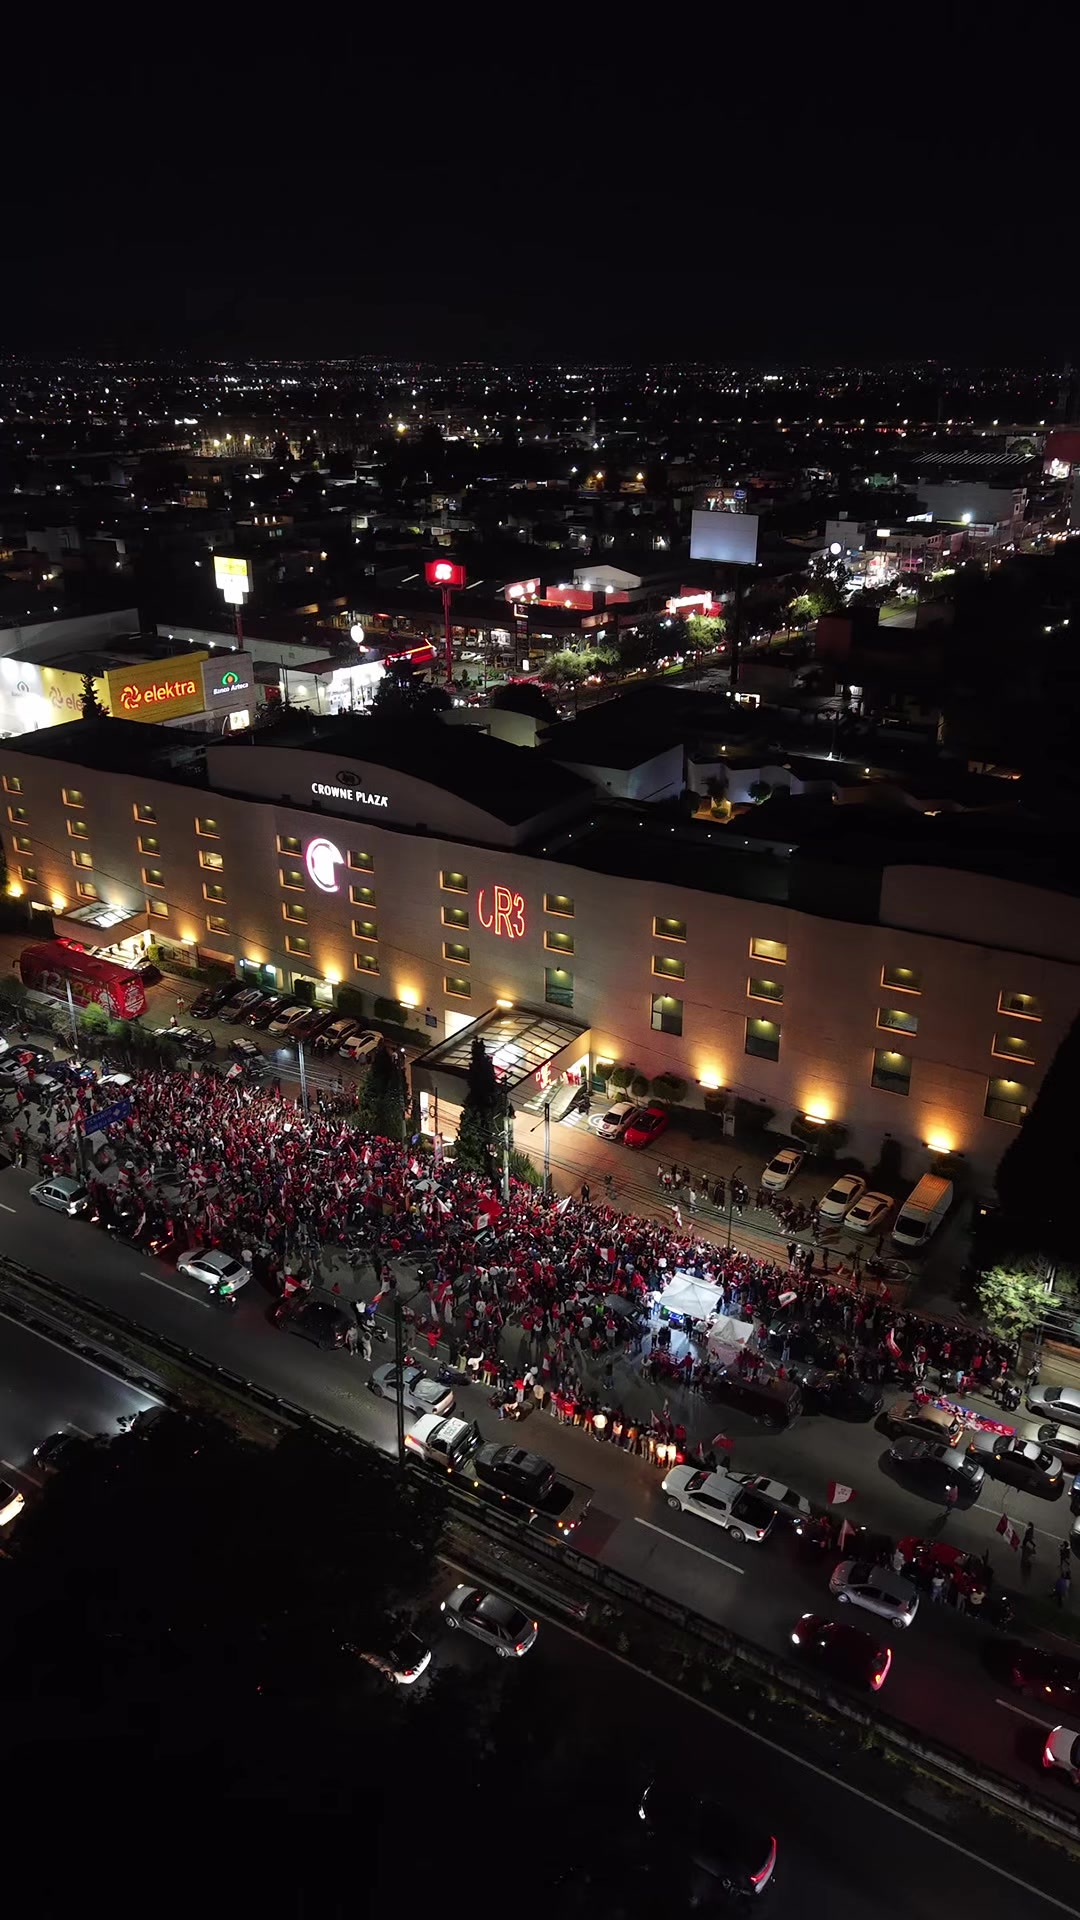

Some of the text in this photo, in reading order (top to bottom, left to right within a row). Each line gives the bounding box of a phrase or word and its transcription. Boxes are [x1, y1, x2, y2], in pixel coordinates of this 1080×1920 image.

[144, 681, 196, 703] elektra
[213, 682, 249, 695] Banco Azteca
[311, 782, 389, 808] CROWNE PLAZA
